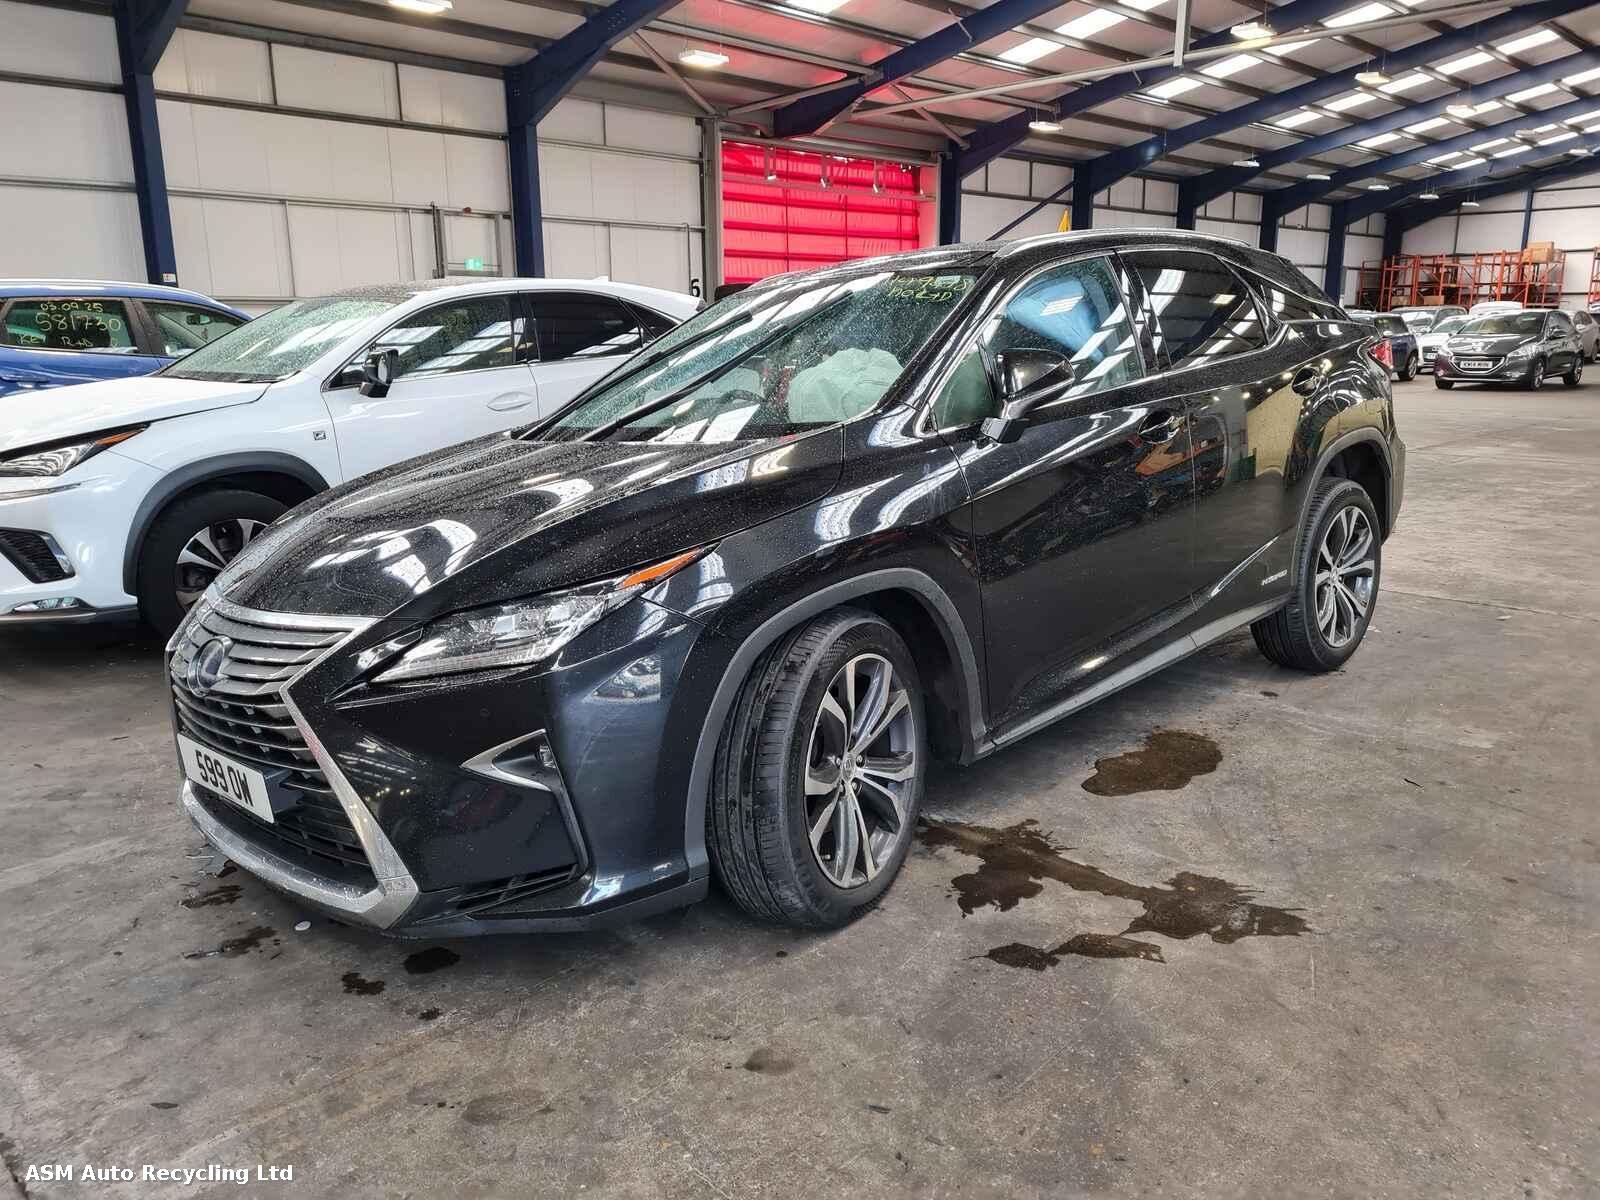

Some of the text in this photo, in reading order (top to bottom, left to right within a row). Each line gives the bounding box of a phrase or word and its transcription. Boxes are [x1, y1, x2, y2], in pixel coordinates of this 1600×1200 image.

[691, 279, 700, 297] 6
[195, 749, 254, 807] 599 OW
